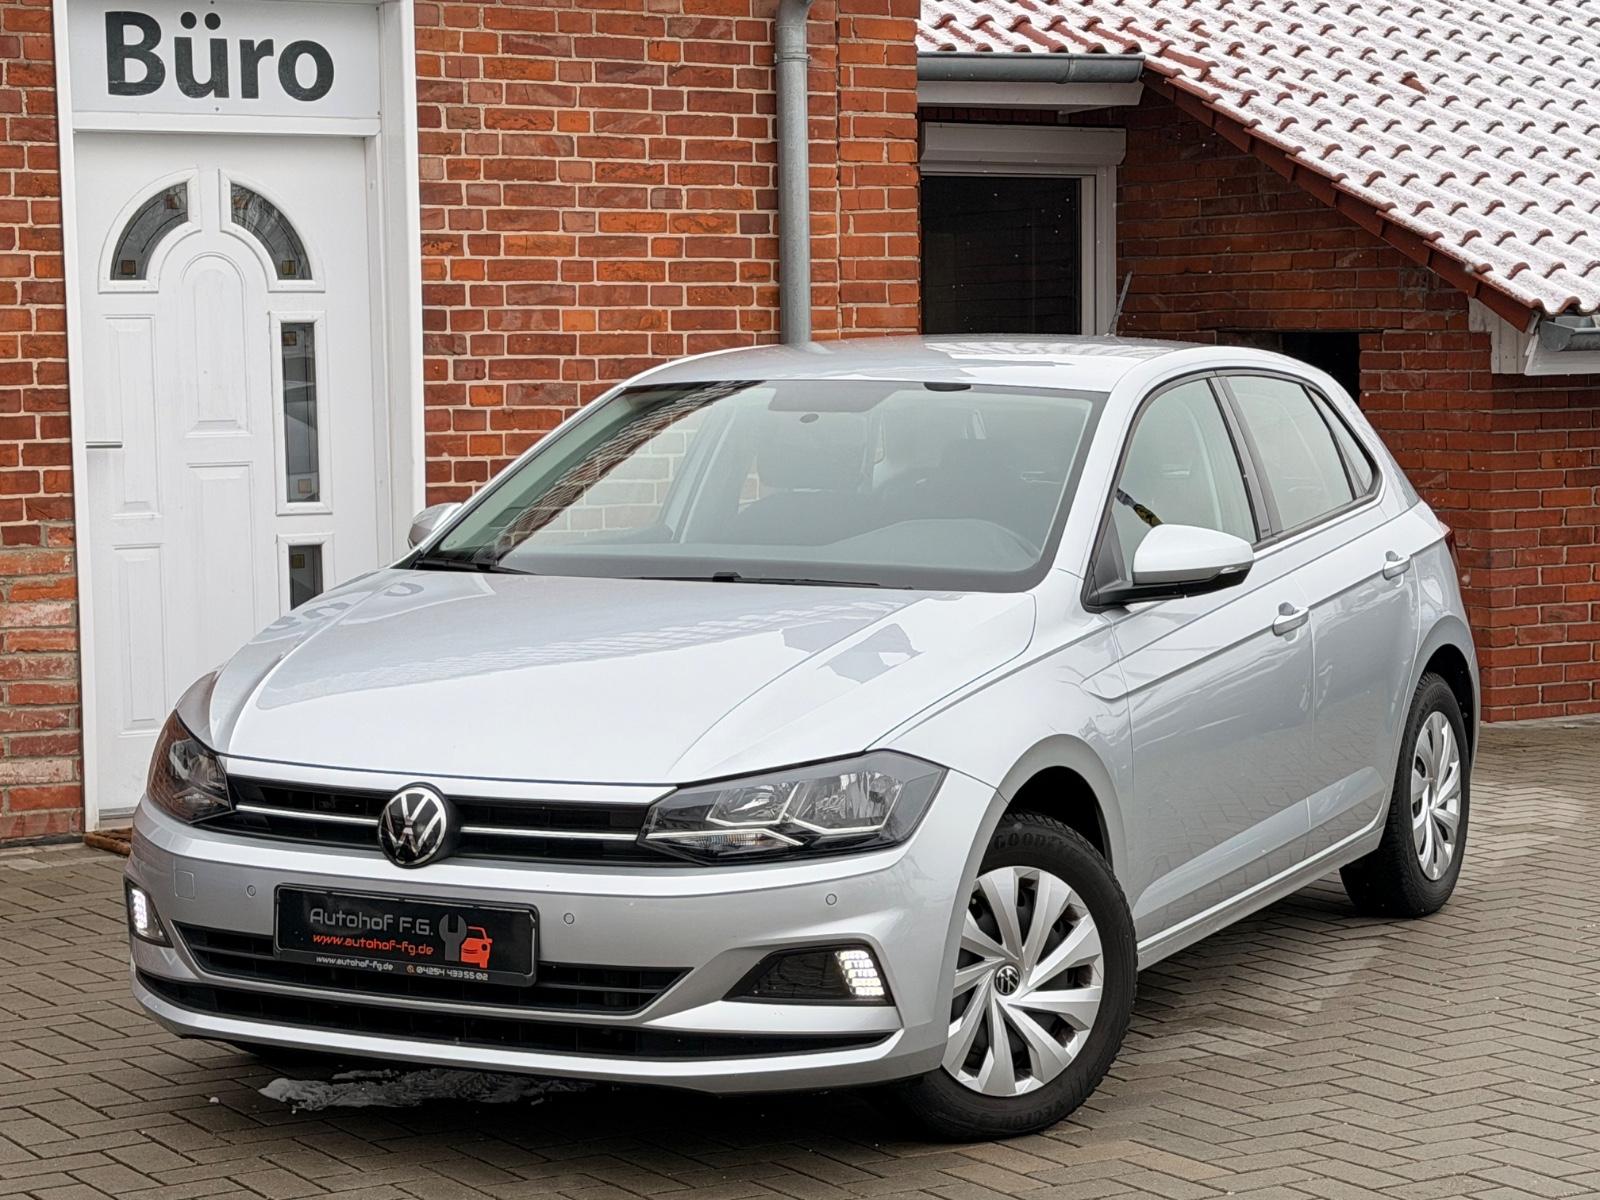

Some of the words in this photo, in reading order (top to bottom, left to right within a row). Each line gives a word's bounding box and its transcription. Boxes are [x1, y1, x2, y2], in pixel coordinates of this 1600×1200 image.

[105, 11, 334, 101] Büro
[310, 908, 394, 931] Autohof
[400, 917, 434, 936] F.G.
[313, 934, 434, 956] www.autohof-fg.de
[316, 956, 394, 971] www.autohof-fg.de
[416, 966, 445, 976] 04254
